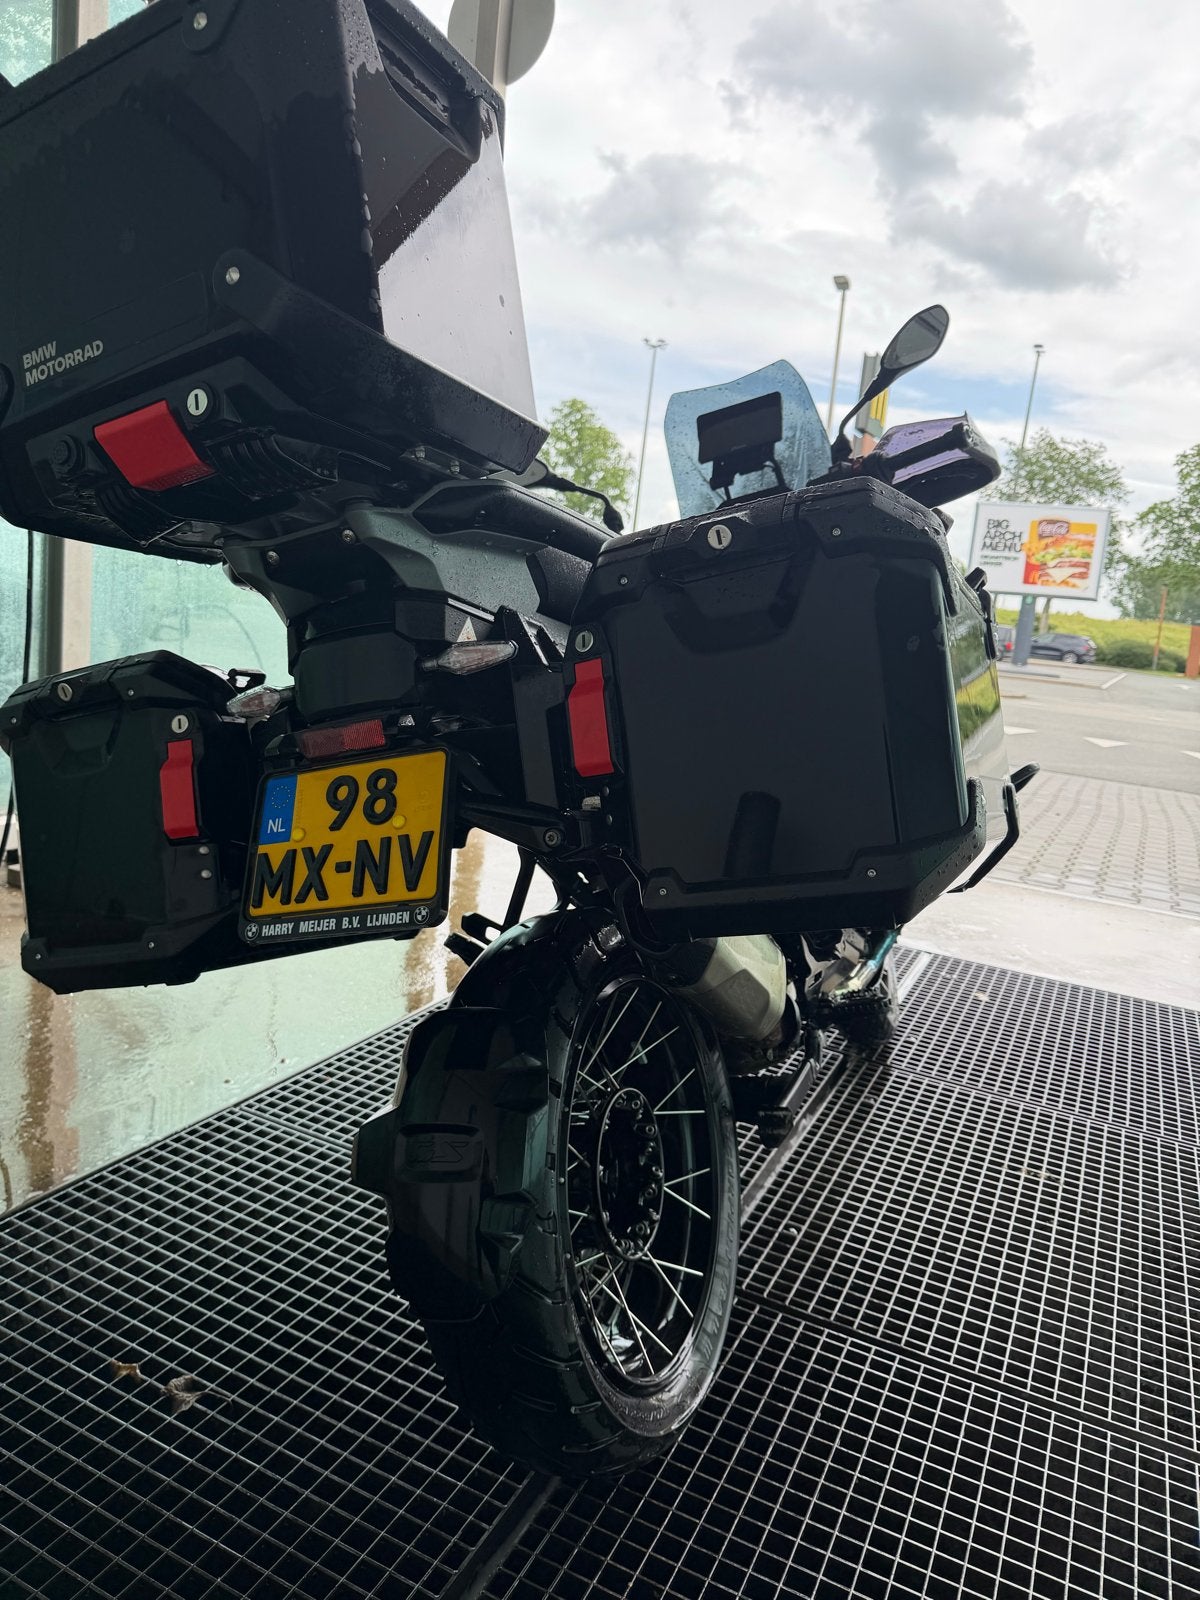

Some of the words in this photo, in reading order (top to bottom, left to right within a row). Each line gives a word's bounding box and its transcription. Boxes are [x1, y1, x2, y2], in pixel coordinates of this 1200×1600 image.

[23, 341, 57, 370] BMW
[25, 340, 104, 387] MOTORRAD
[983, 530, 1022, 542] ARCH
[987, 519, 1010, 530] BIG
[981, 541, 1023, 553] MENU
[326, 768, 398, 832] 98
[267, 817, 285, 834] NL
[251, 831, 435, 909] MX-NV
[262, 919, 294, 937] HARRY
[299, 917, 337, 934] MEIJER
[342, 915, 361, 929] B.V.
[367, 911, 410, 927] LIJNDEN
